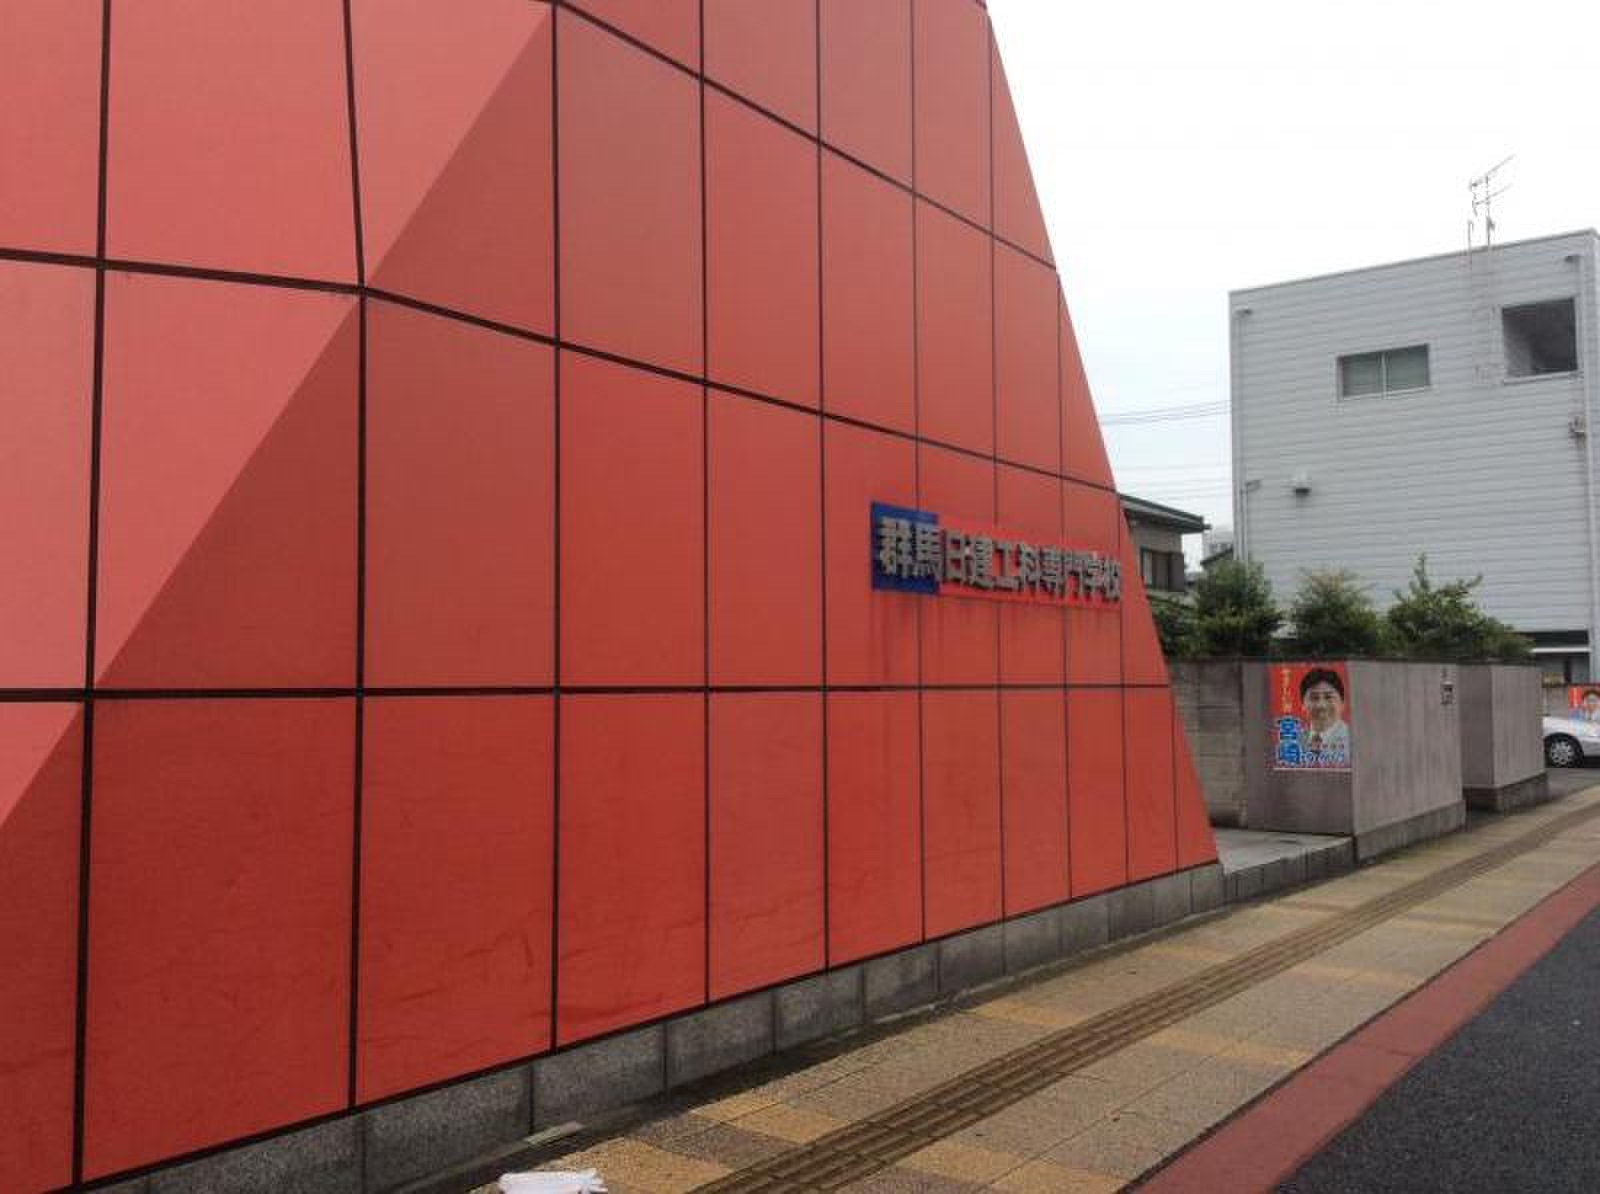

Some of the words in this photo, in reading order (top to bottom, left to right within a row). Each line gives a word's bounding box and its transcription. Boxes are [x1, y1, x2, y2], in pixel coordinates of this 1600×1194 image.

[879, 515, 1121, 602] 群馬日建工科専門学校
